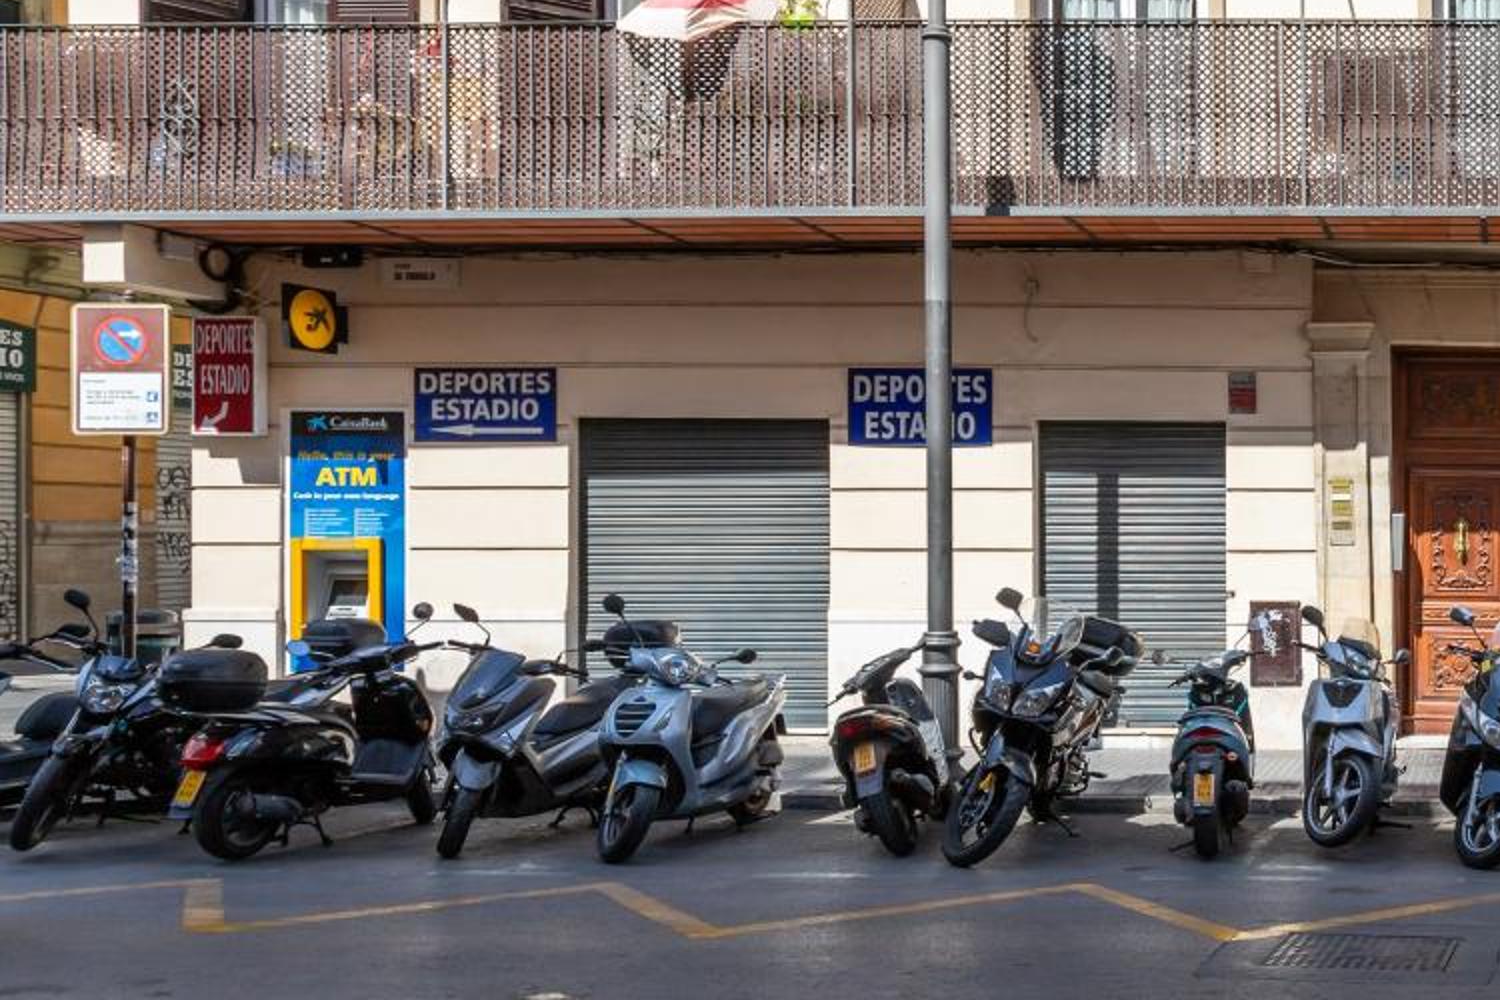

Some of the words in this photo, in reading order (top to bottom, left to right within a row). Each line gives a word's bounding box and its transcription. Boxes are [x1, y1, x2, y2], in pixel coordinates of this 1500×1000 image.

[196, 325, 255, 354] DEPORTES
[201, 365, 250, 395] ESTADIO
[419, 372, 550, 394] DEPORTES
[853, 375, 987, 404] DEPOES
[431, 398, 539, 420] ESTADIO
[315, 467, 377, 486] ATM
